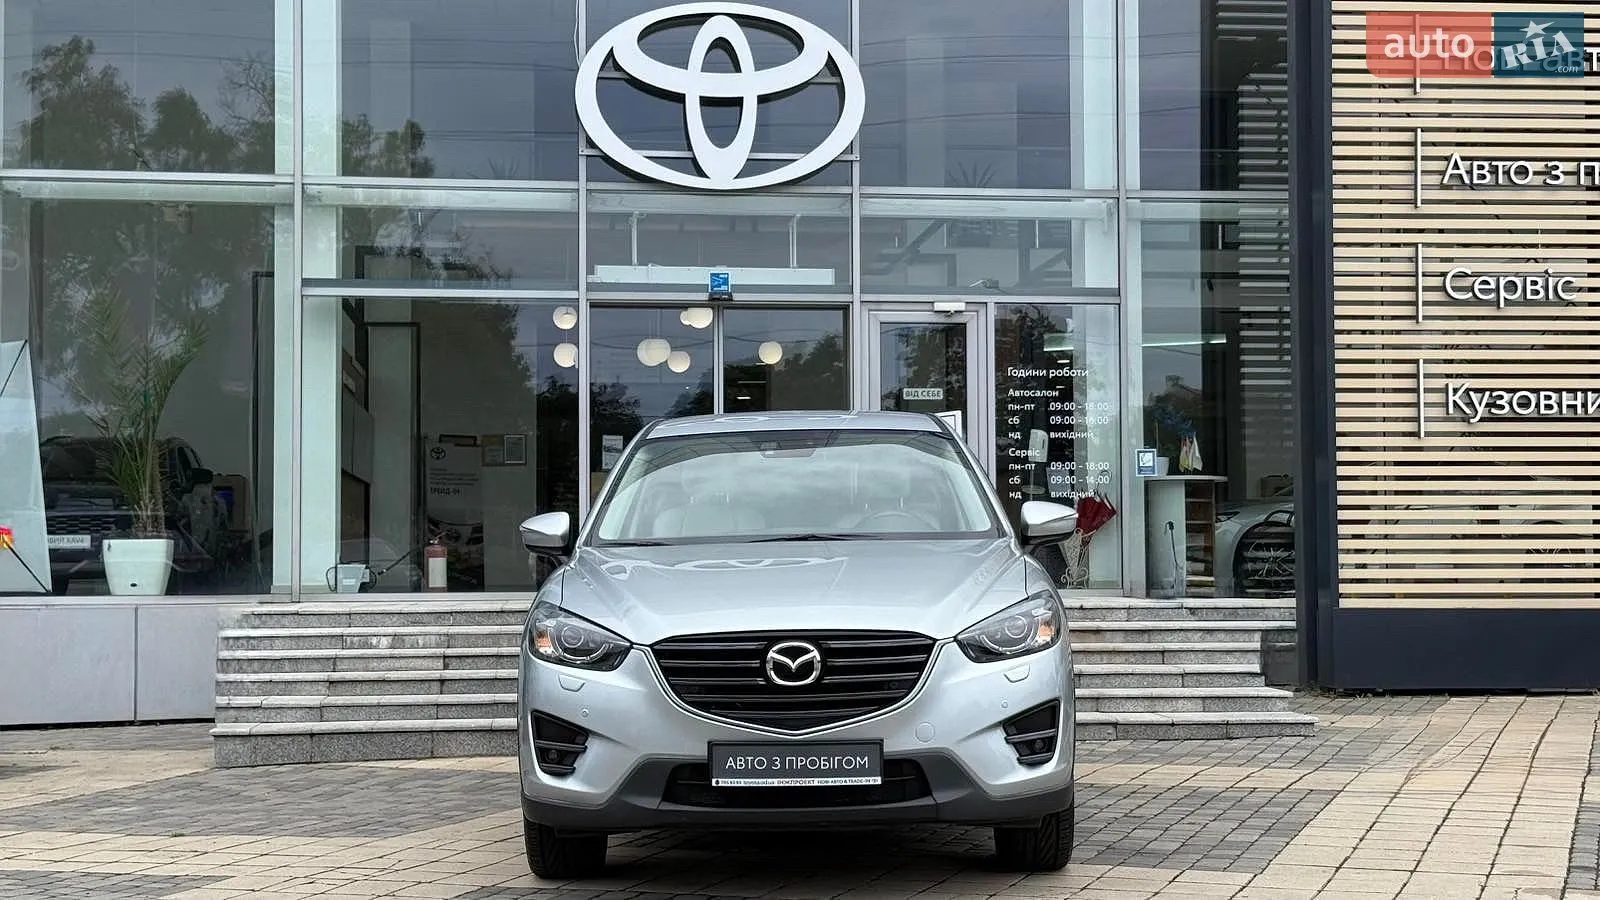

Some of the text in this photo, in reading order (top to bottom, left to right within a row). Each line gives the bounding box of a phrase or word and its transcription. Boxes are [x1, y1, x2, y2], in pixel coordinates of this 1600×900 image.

[1442, 152, 1533, 185] Авто
[1445, 267, 1577, 308] Сервіс
[1007, 366, 1089, 379] Години роботи
[1007, 388, 1059, 397] Автосалон
[1007, 403, 1035, 411] пн-пт
[1049, 402, 1076, 411] 09:00
[1007, 415, 1020, 425] сб
[1049, 416, 1076, 425] 09:00
[1008, 430, 1095, 440] нд вихідний
[1008, 447, 1041, 458] Сервіс
[1050, 461, 1076, 470] 09:00
[1086, 461, 1110, 470] 18:00
[1008, 475, 1021, 485] сб
[1050, 475, 1076, 484] 09:00
[1009, 489, 1095, 499] нд вихідний
[725, 756, 869, 770] АВТО З ПРОБІГОМ
